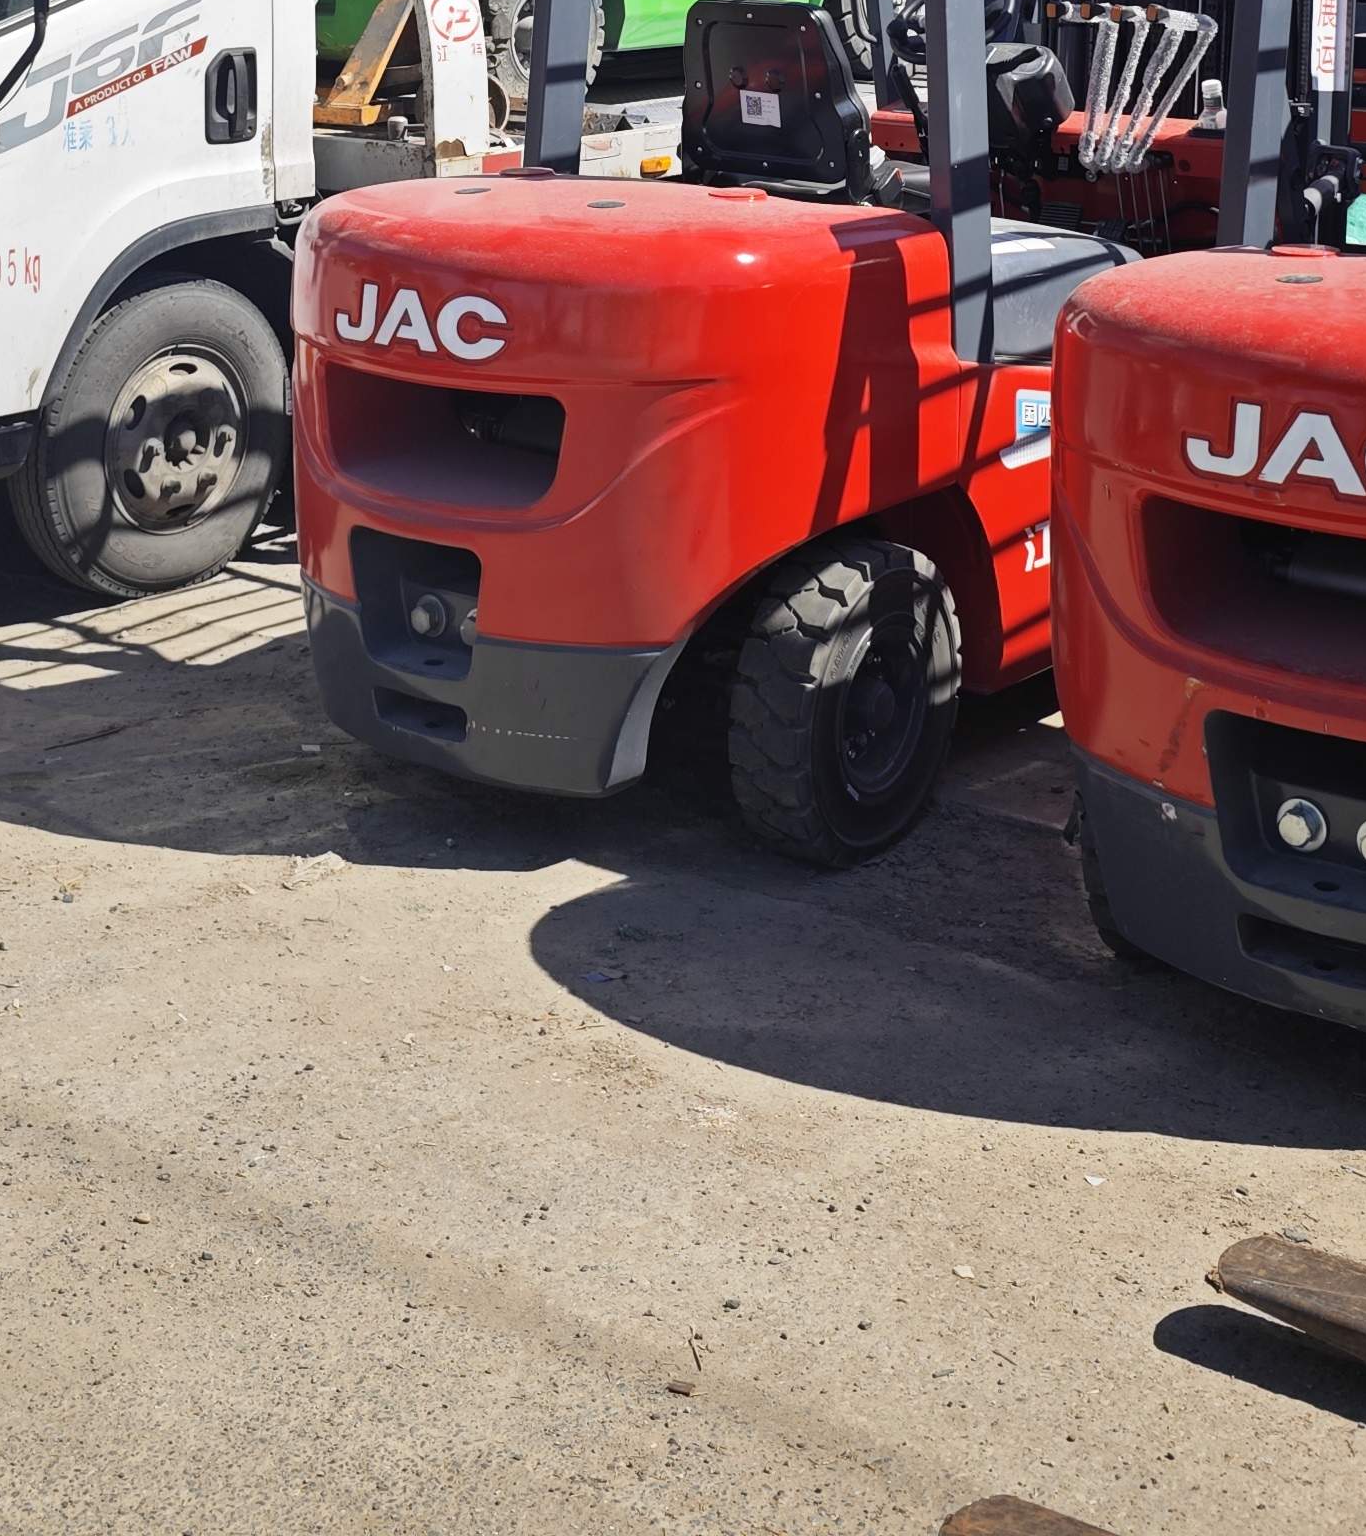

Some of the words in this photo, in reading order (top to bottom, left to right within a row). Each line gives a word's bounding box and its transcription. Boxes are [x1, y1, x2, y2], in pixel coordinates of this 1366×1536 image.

[74, 101, 83, 113] A
[84, 78, 132, 108] PRODUCT
[132, 69, 148, 84] OF
[150, 44, 193, 76] FAW
[336, 280, 508, 360] JAC
